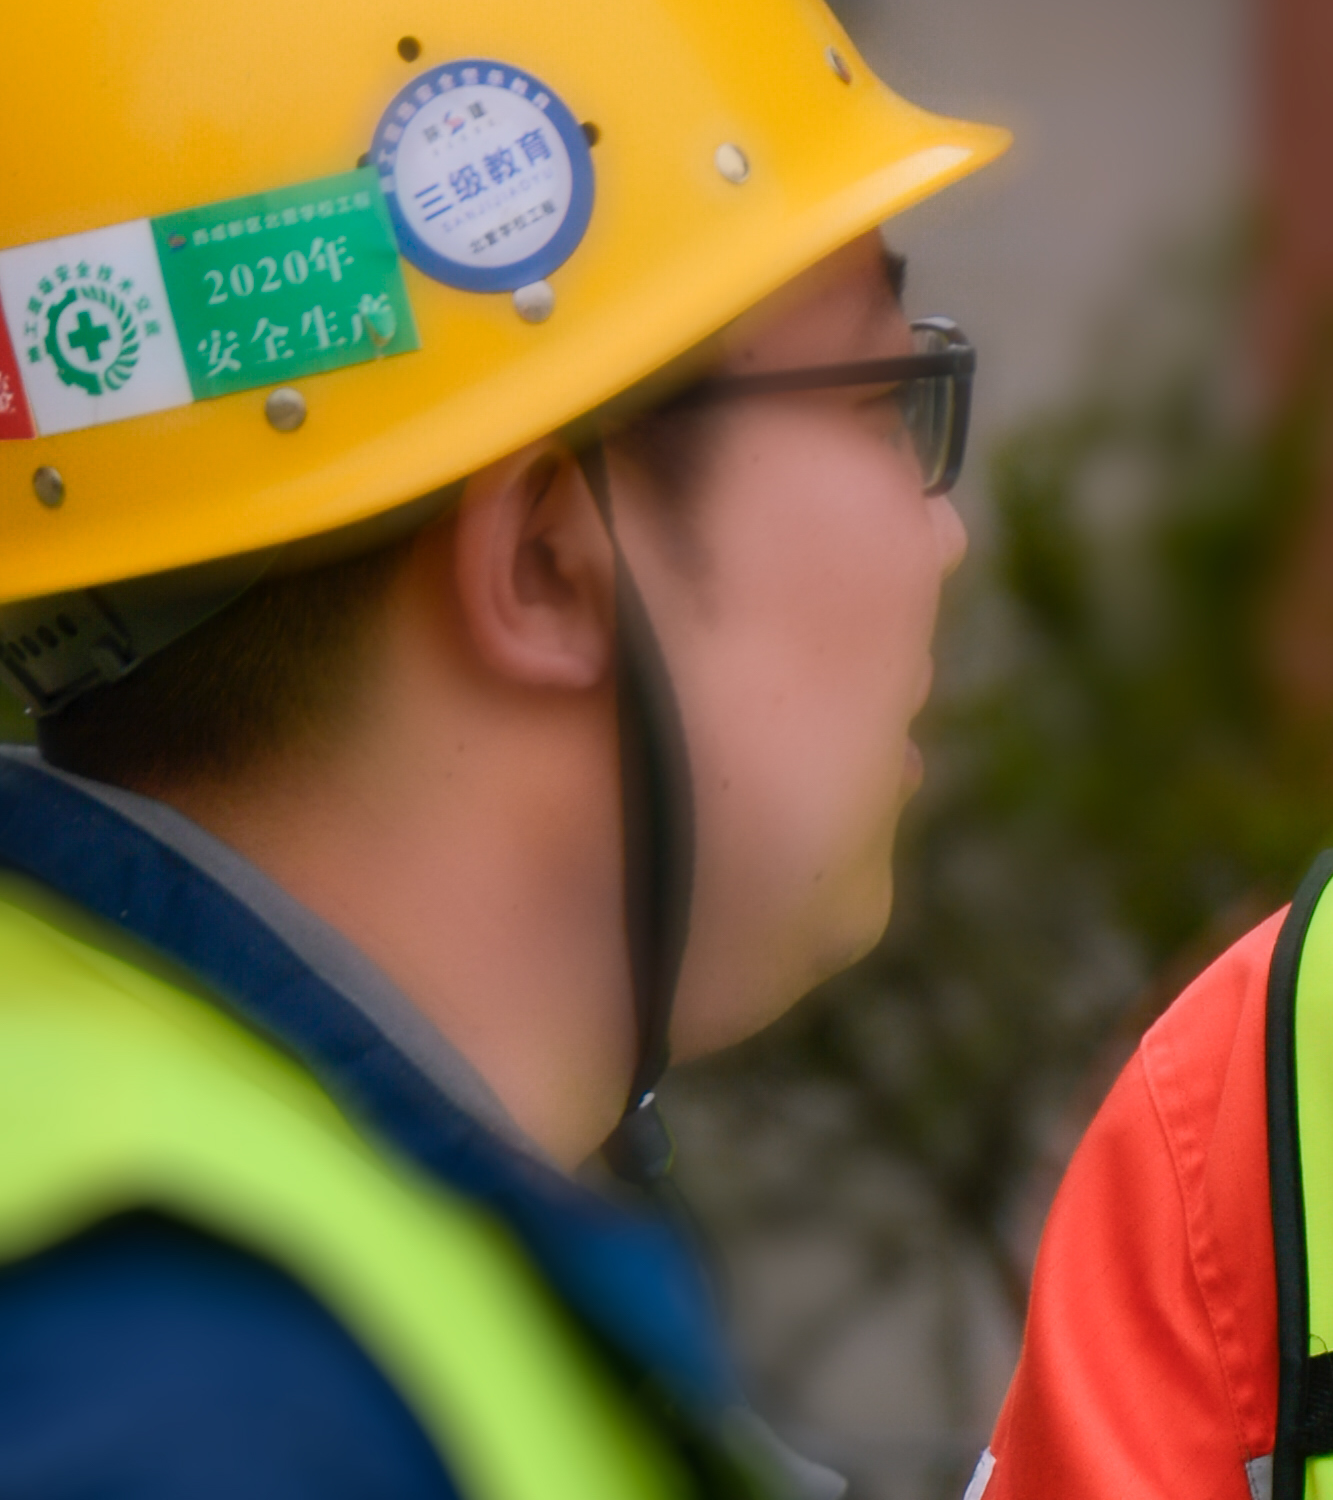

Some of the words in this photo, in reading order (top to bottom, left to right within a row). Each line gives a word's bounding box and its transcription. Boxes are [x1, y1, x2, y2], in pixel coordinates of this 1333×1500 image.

[412, 126, 555, 224] 三级教育
[203, 235, 355, 306] 2020年
[196, 292, 398, 378] 安全生产
